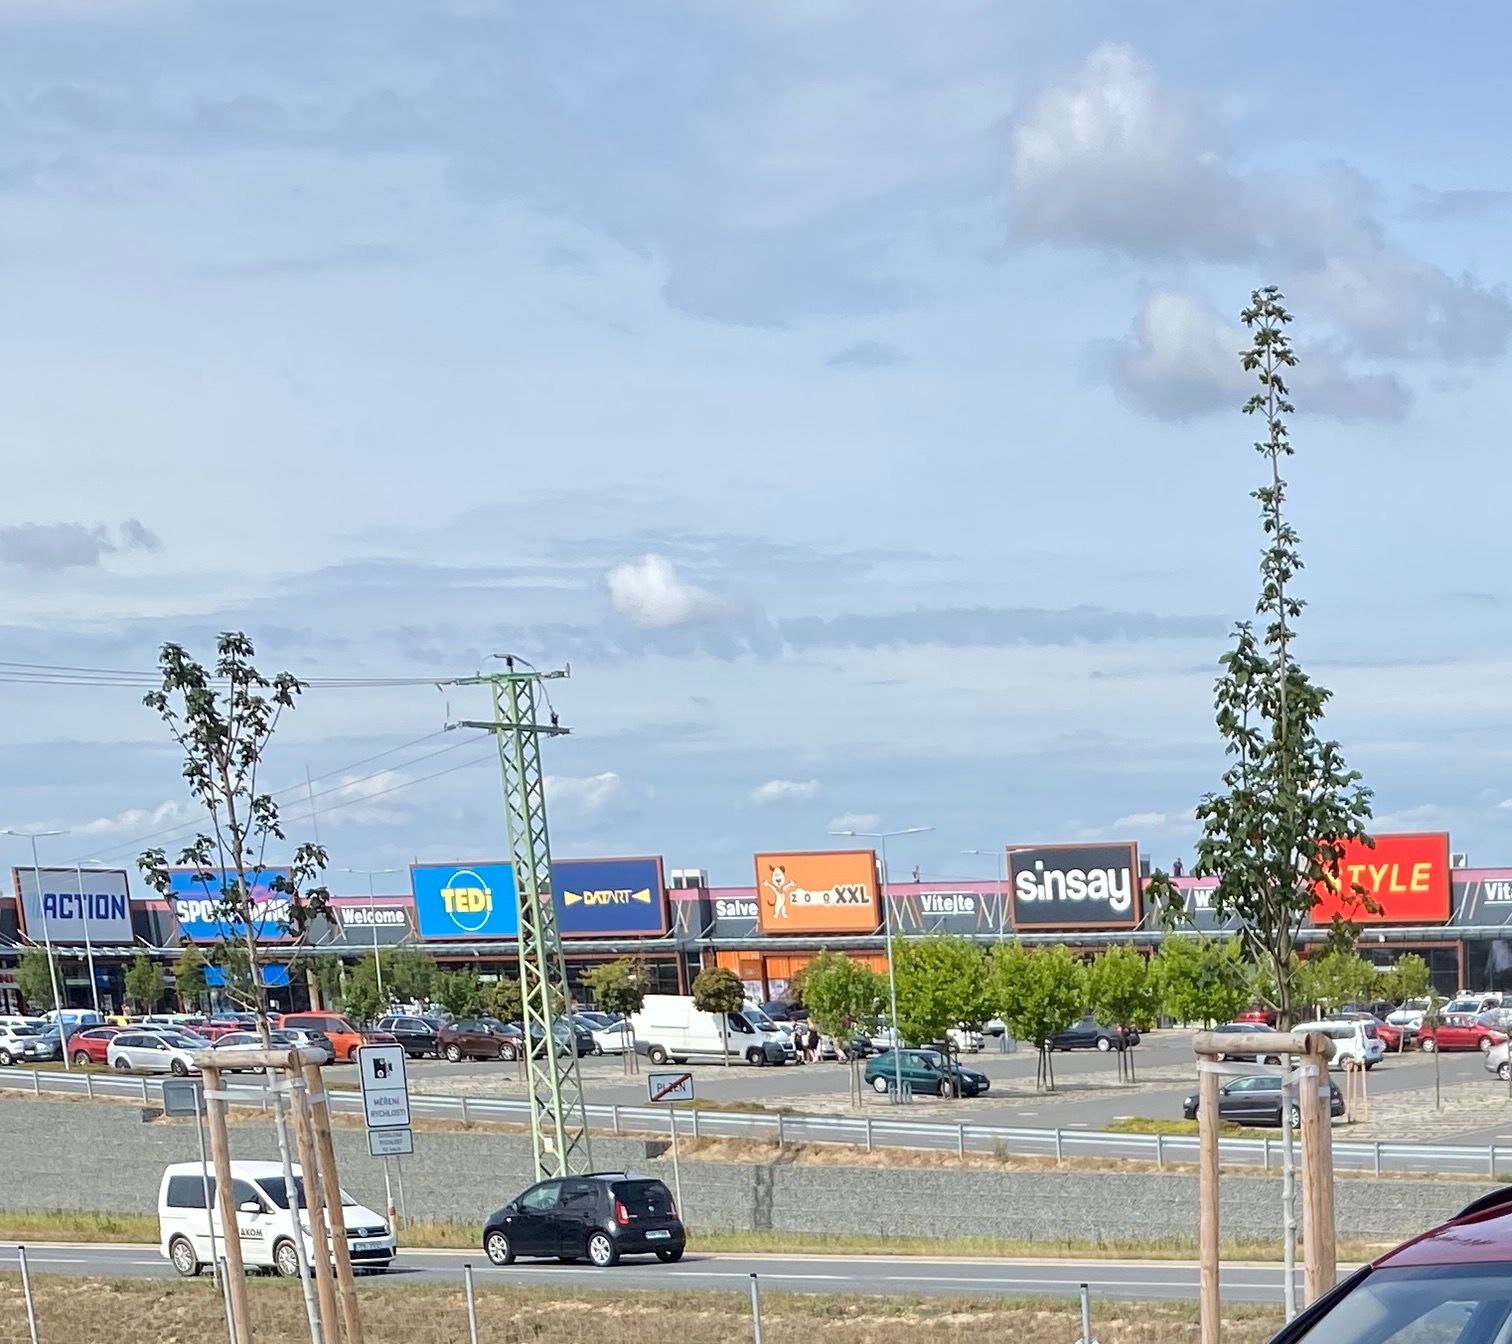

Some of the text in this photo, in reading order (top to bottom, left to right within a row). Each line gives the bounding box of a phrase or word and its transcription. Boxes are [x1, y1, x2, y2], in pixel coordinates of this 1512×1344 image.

[1016, 860, 1132, 910] sinsay
[583, 890, 632, 904] DATART
[834, 886, 870, 904] XXL
[43, 893, 126, 920] ACTION
[716, 898, 758, 916] Salve
[921, 894, 974, 915] Vítejte
[341, 908, 405, 924] Welcome
